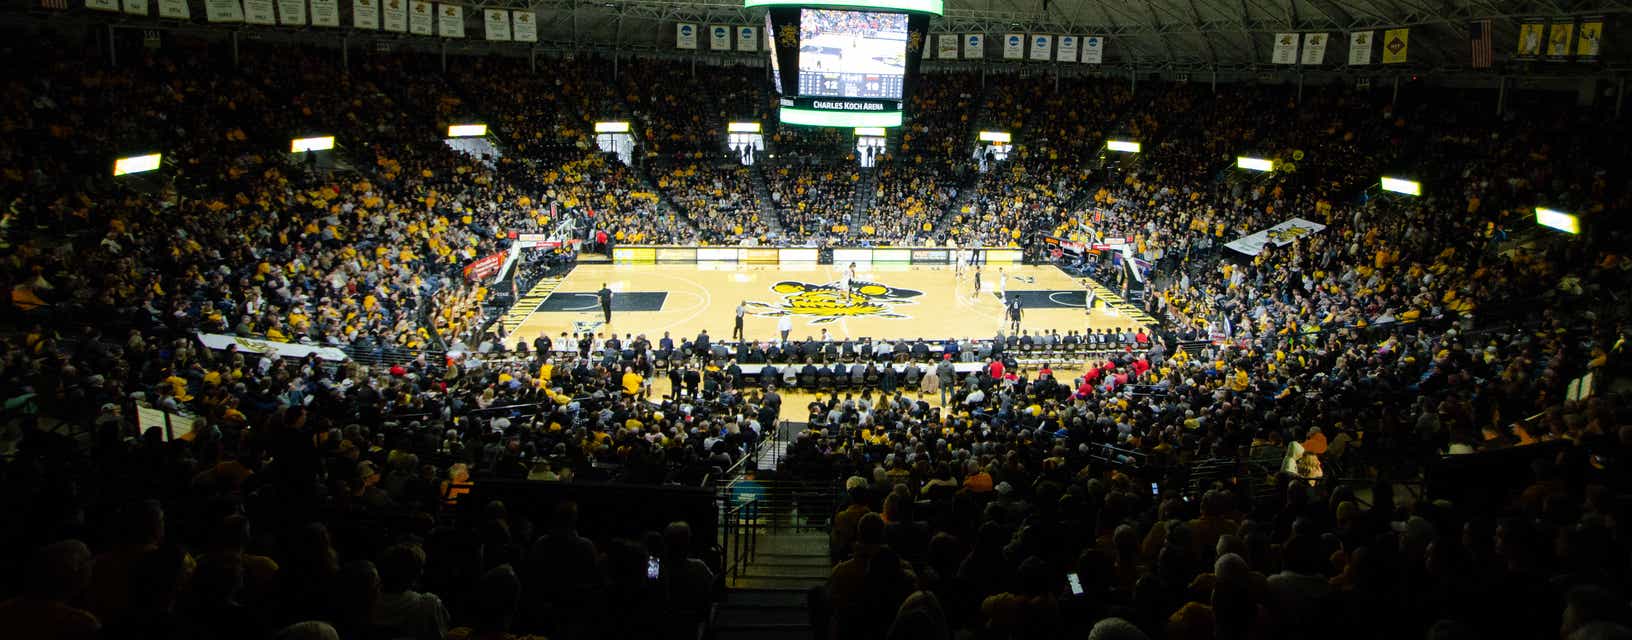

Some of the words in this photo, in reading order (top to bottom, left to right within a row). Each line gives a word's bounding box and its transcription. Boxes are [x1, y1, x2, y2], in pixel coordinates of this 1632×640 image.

[813, 100, 843, 110] CHARLES
[843, 101, 863, 111] KOCH
[863, 102, 884, 111] ARENA
